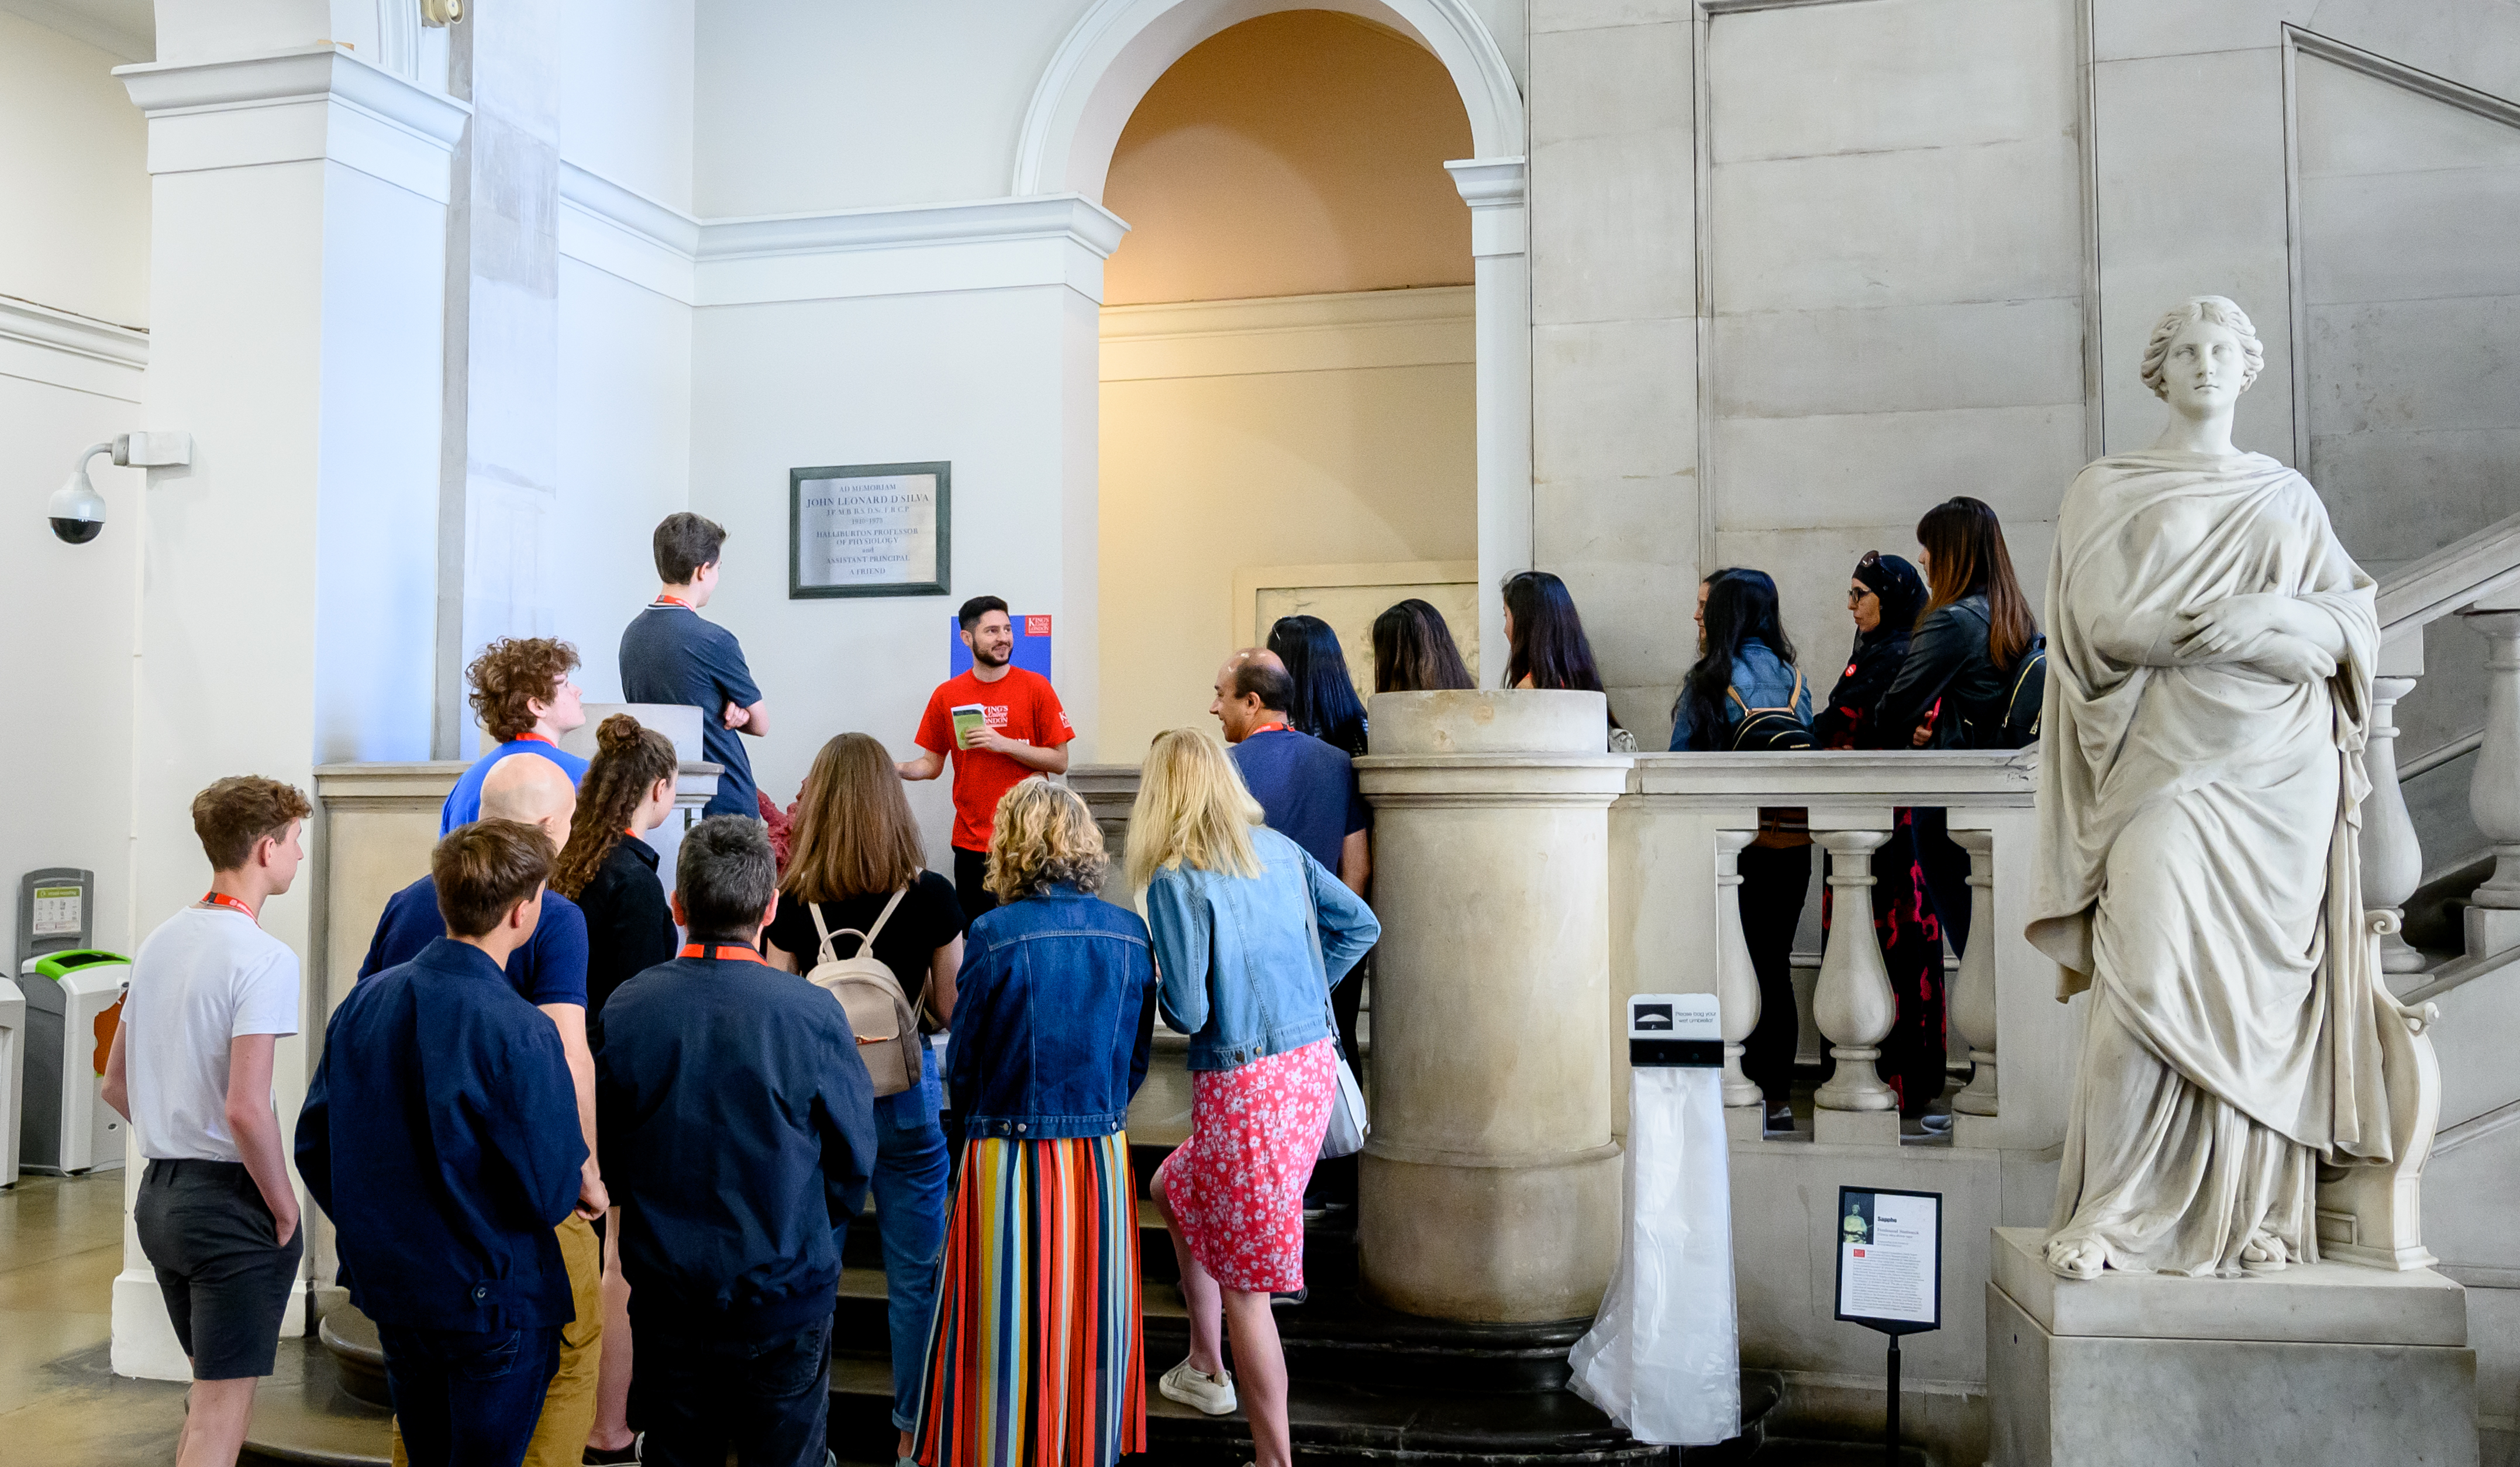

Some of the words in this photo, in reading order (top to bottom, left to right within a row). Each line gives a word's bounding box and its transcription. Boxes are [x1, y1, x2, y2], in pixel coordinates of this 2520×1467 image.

[806, 498, 834, 508] JOHN
[838, 495, 888, 505] LEONARD
[816, 529, 872, 538] HALLIBURTON
[874, 528, 918, 536] PROFESSOR
[849, 537, 898, 545] PHYSIOLOGY
